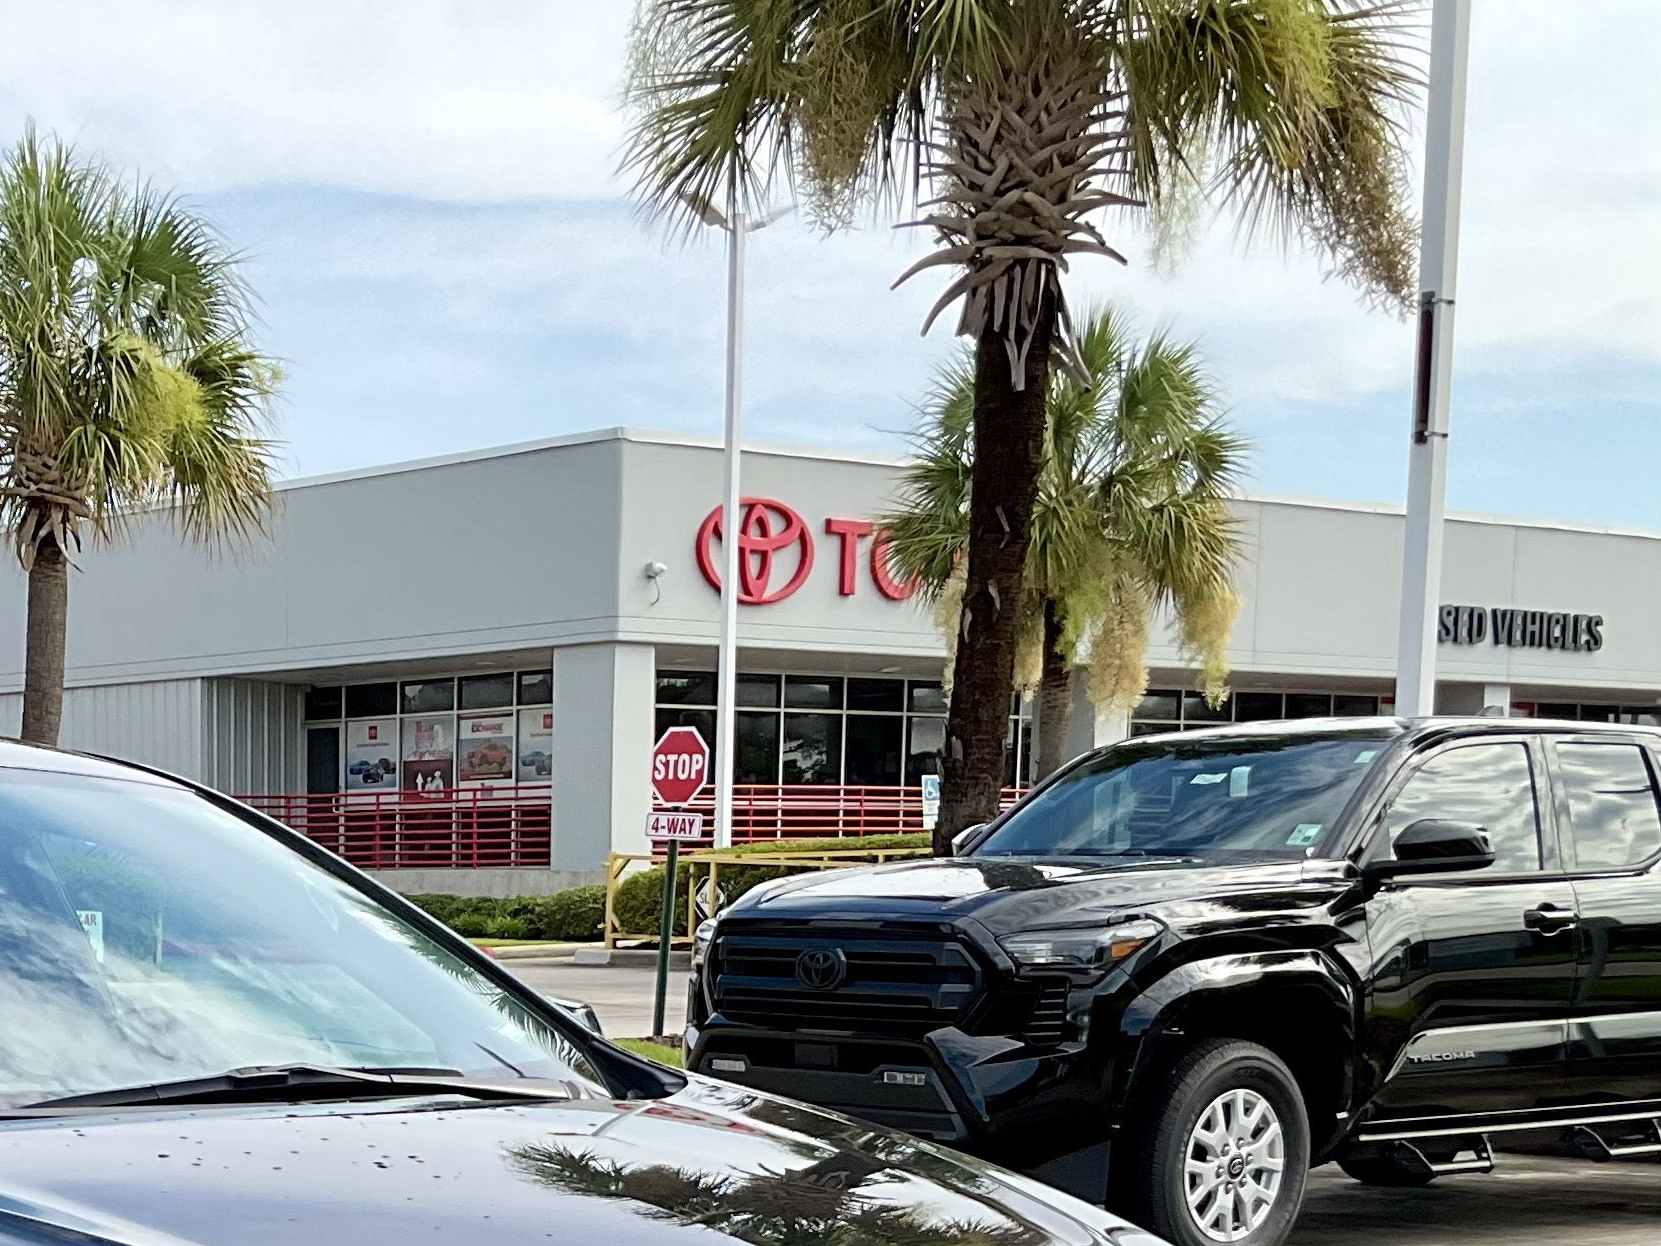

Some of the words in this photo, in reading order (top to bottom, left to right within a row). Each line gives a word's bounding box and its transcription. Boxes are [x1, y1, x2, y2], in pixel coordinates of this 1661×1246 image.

[1439, 604, 1488, 645] SED
[1491, 608, 1603, 651] VEHICLES
[653, 753, 704, 781] STOP
[651, 817, 696, 835] 4-WAY
[700, 892, 721, 904] SLW
[1410, 1050, 1476, 1064] TACOMA
